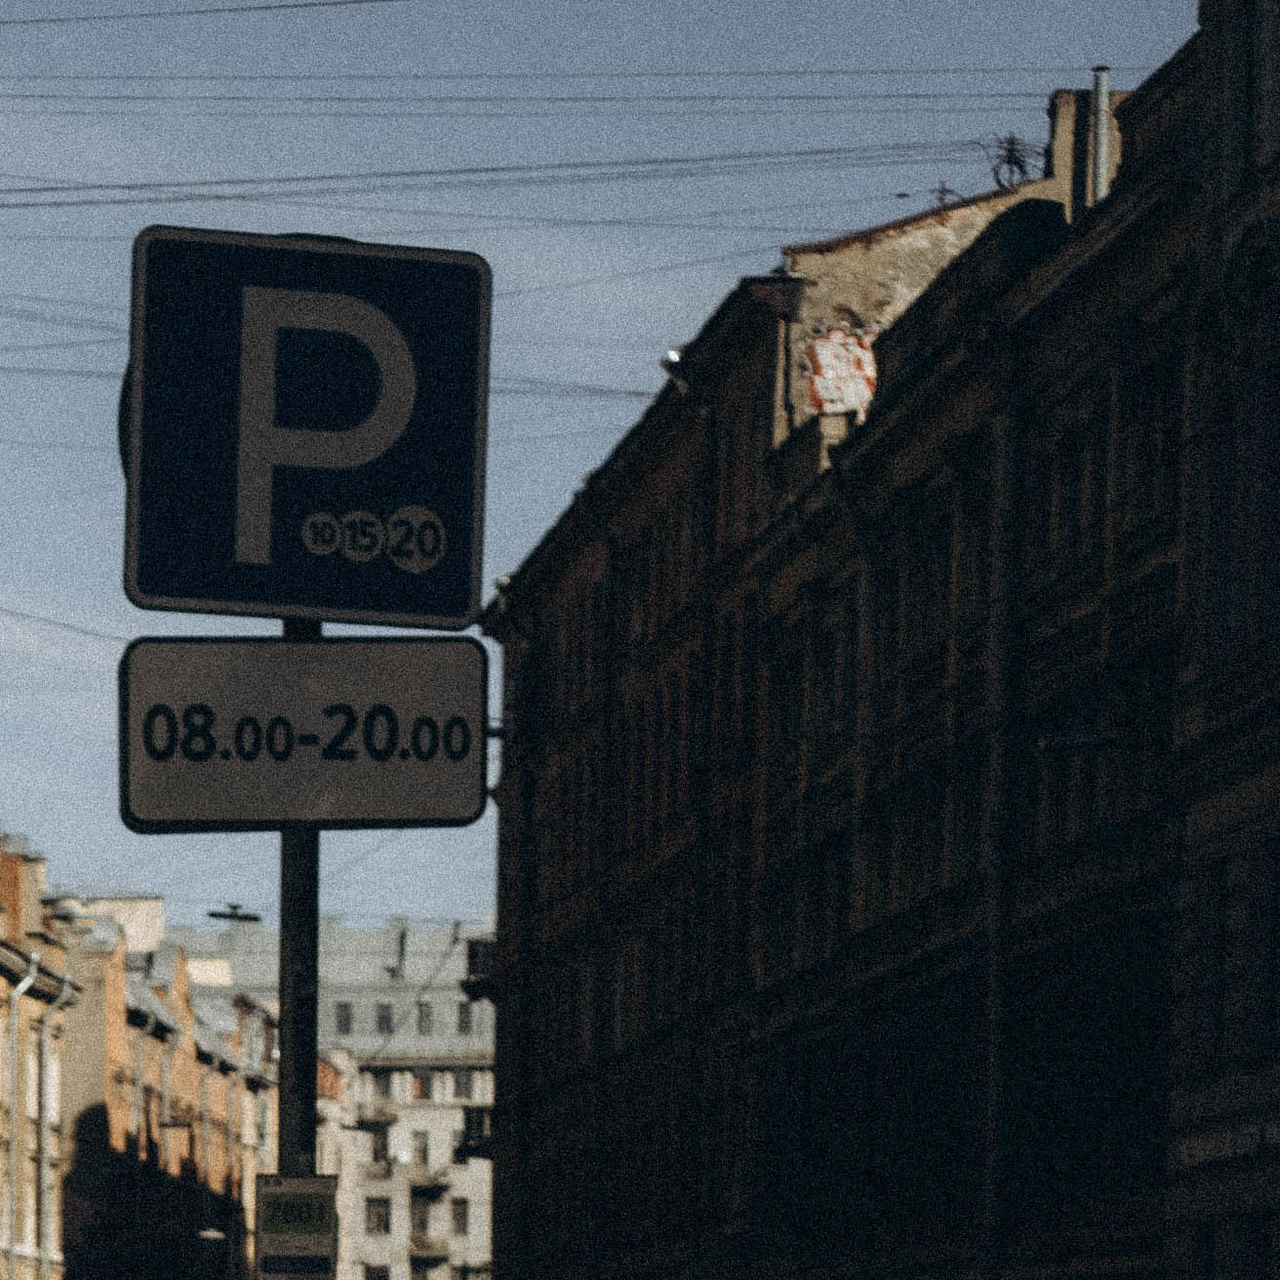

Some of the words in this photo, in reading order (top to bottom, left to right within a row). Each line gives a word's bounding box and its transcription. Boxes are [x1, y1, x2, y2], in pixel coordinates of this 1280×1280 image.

[235, 287, 418, 566] P
[309, 521, 337, 546] 10
[344, 519, 379, 552] 15
[390, 519, 441, 558] 20
[142, 702, 472, 763] 08.00-20.00
